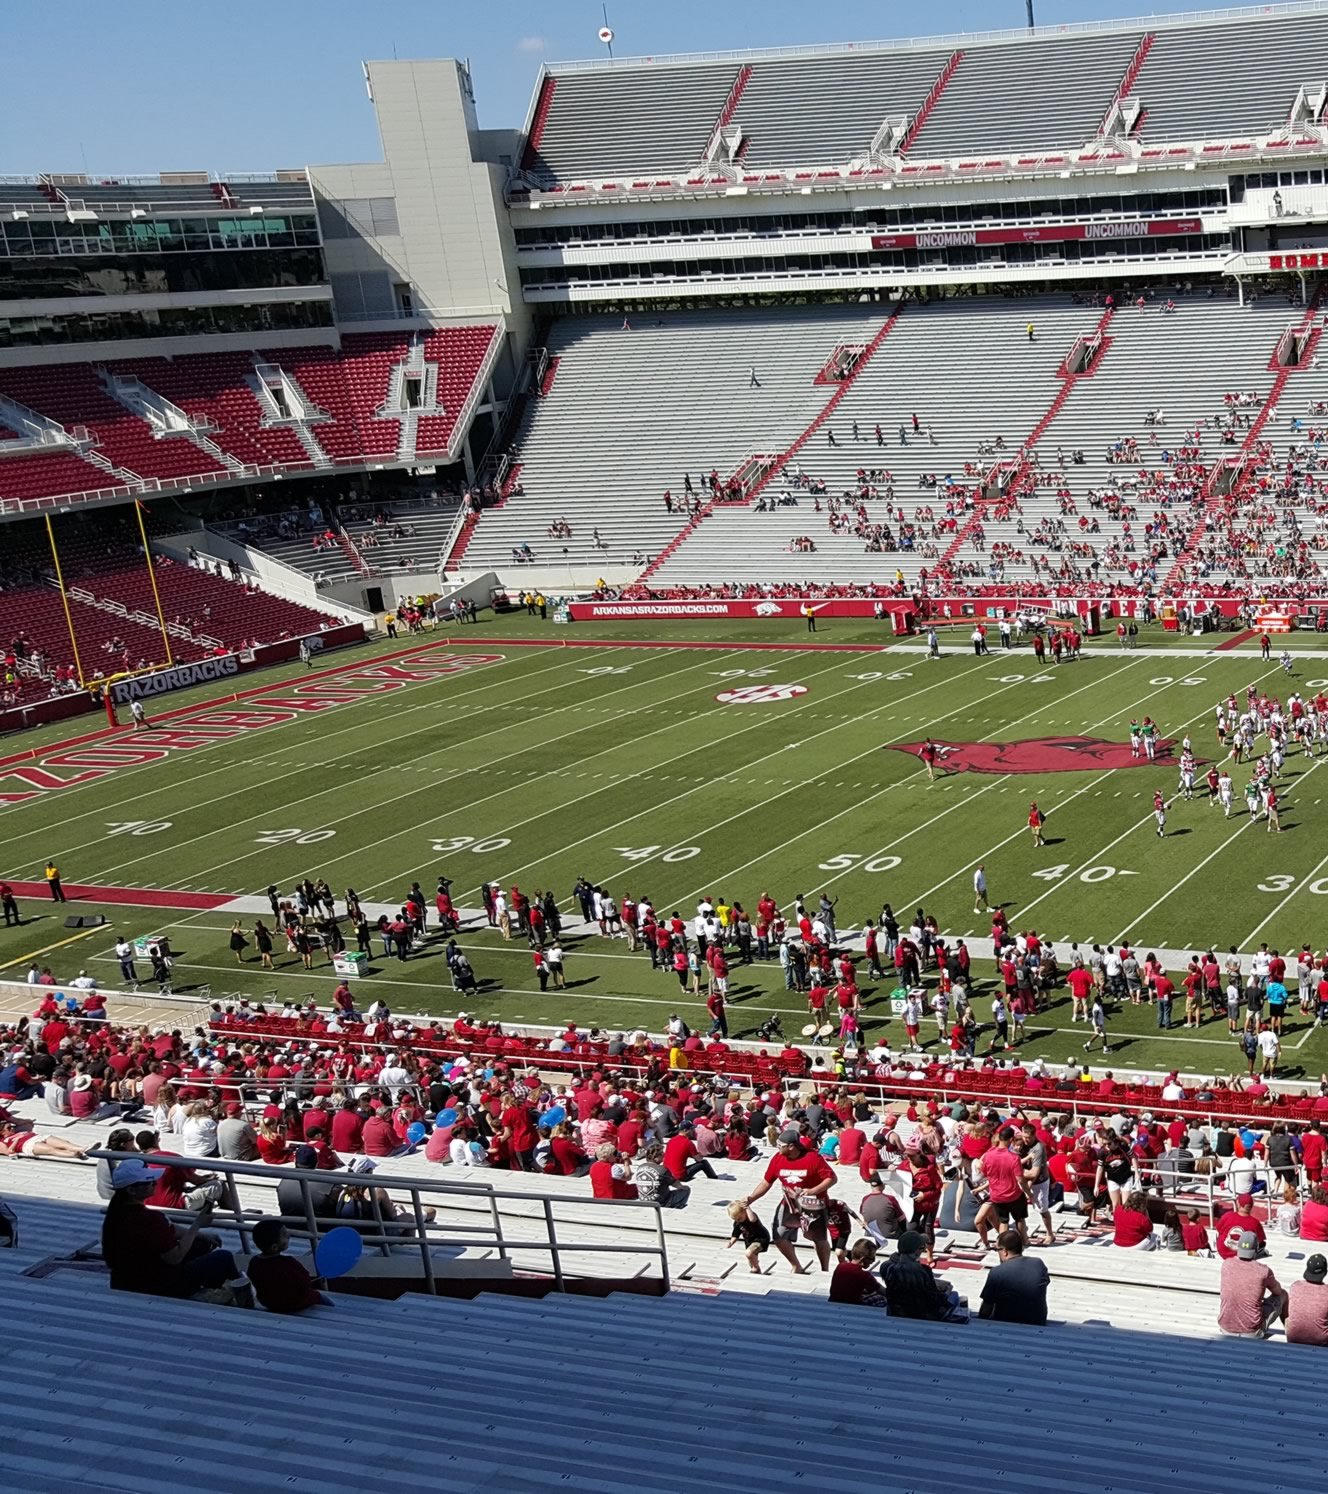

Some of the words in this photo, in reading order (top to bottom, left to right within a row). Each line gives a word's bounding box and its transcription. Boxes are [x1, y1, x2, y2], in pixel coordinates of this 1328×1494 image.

[1085, 222, 1149, 238] UNCOMMON
[916, 232, 977, 247] UNCOMMON
[593, 605, 729, 616] ARKANSASRAZORBACKS.COM
[1052, 601, 1214, 617] UNIERTY
[114, 656, 239, 702] RAZORBACKS
[1149, 677, 1208, 686] 50
[254, 828, 337, 844] 20
[431, 836, 512, 853] 30
[619, 844, 701, 862] 40
[818, 853, 903, 872] 50
[1031, 863, 1116, 883] 40
